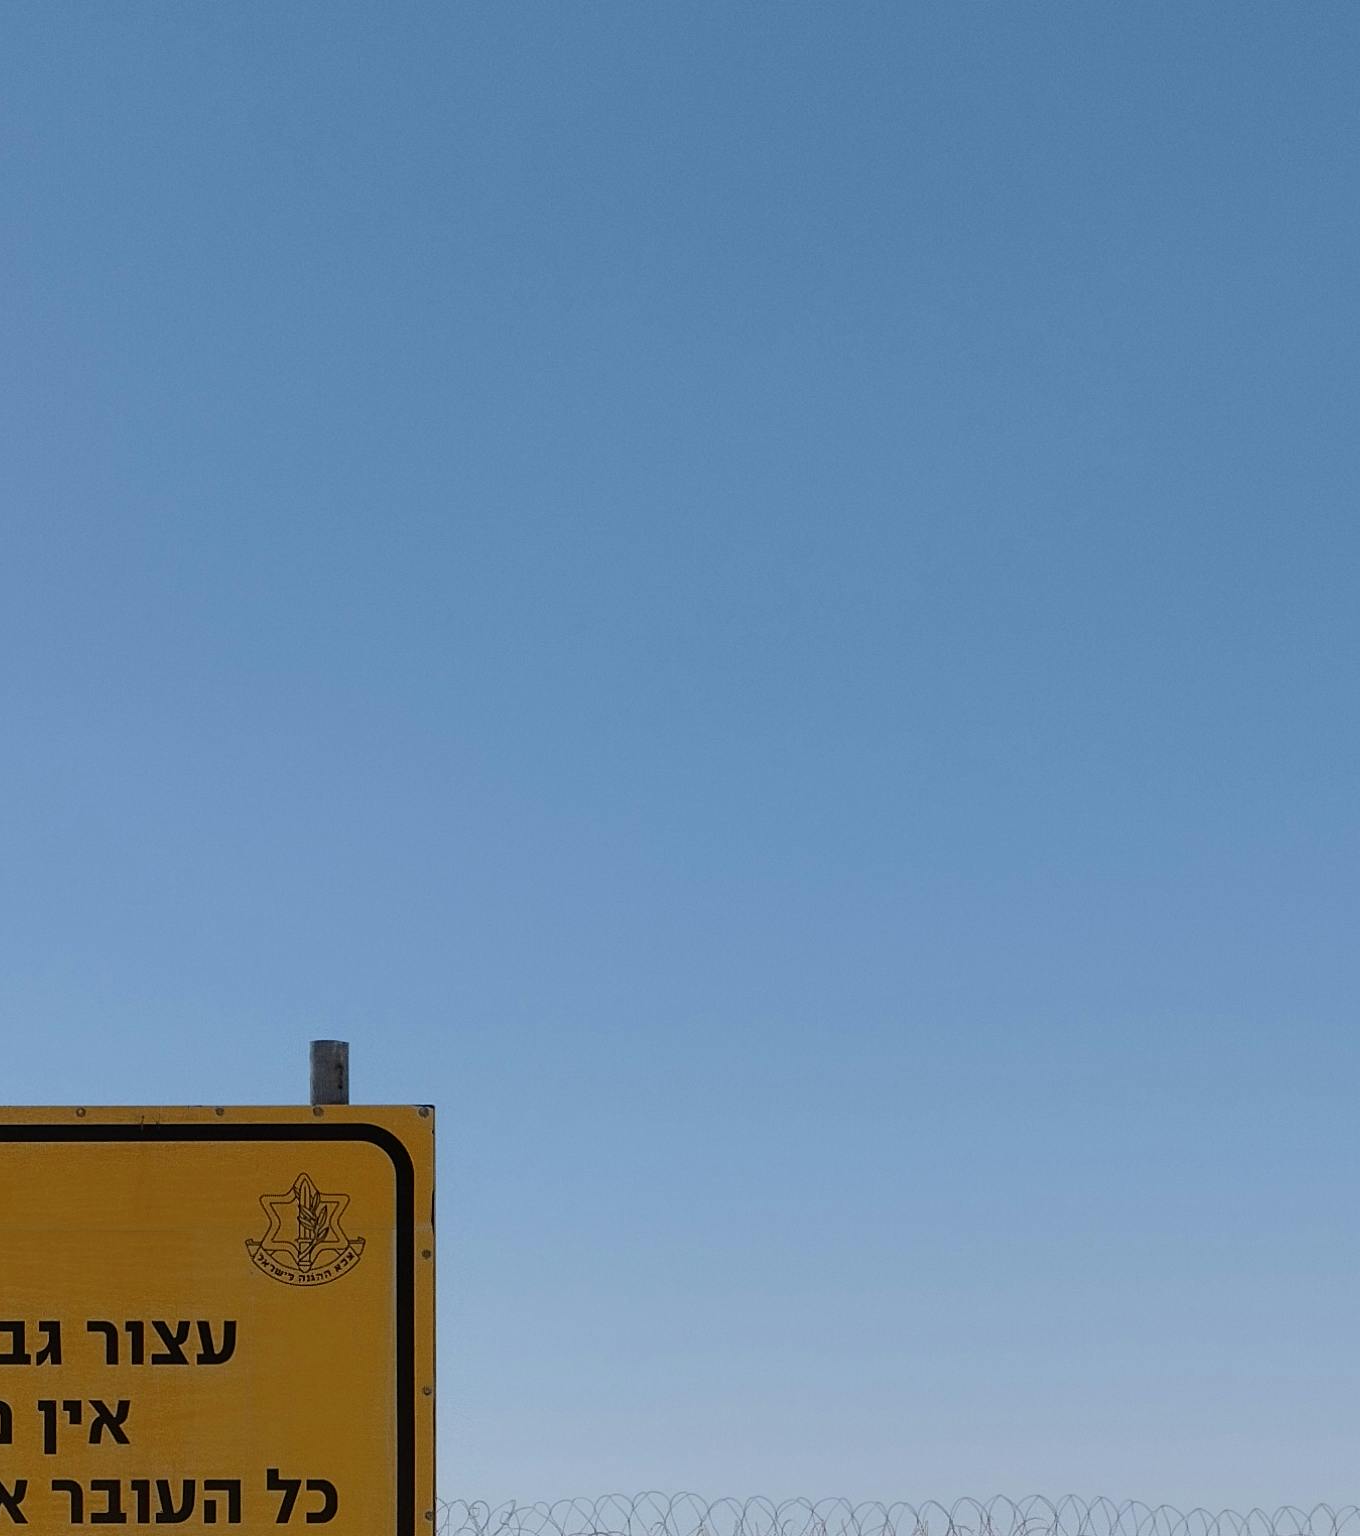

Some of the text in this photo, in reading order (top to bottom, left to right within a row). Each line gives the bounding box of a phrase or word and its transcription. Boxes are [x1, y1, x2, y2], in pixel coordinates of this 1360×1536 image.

[257, 1252, 295, 1281] לישראל
[86, 1320, 237, 1367] עצור
[37, 1399, 131, 1455] אין
[51, 1479, 242, 1525] העובר
[266, 1468, 338, 1524] כל
